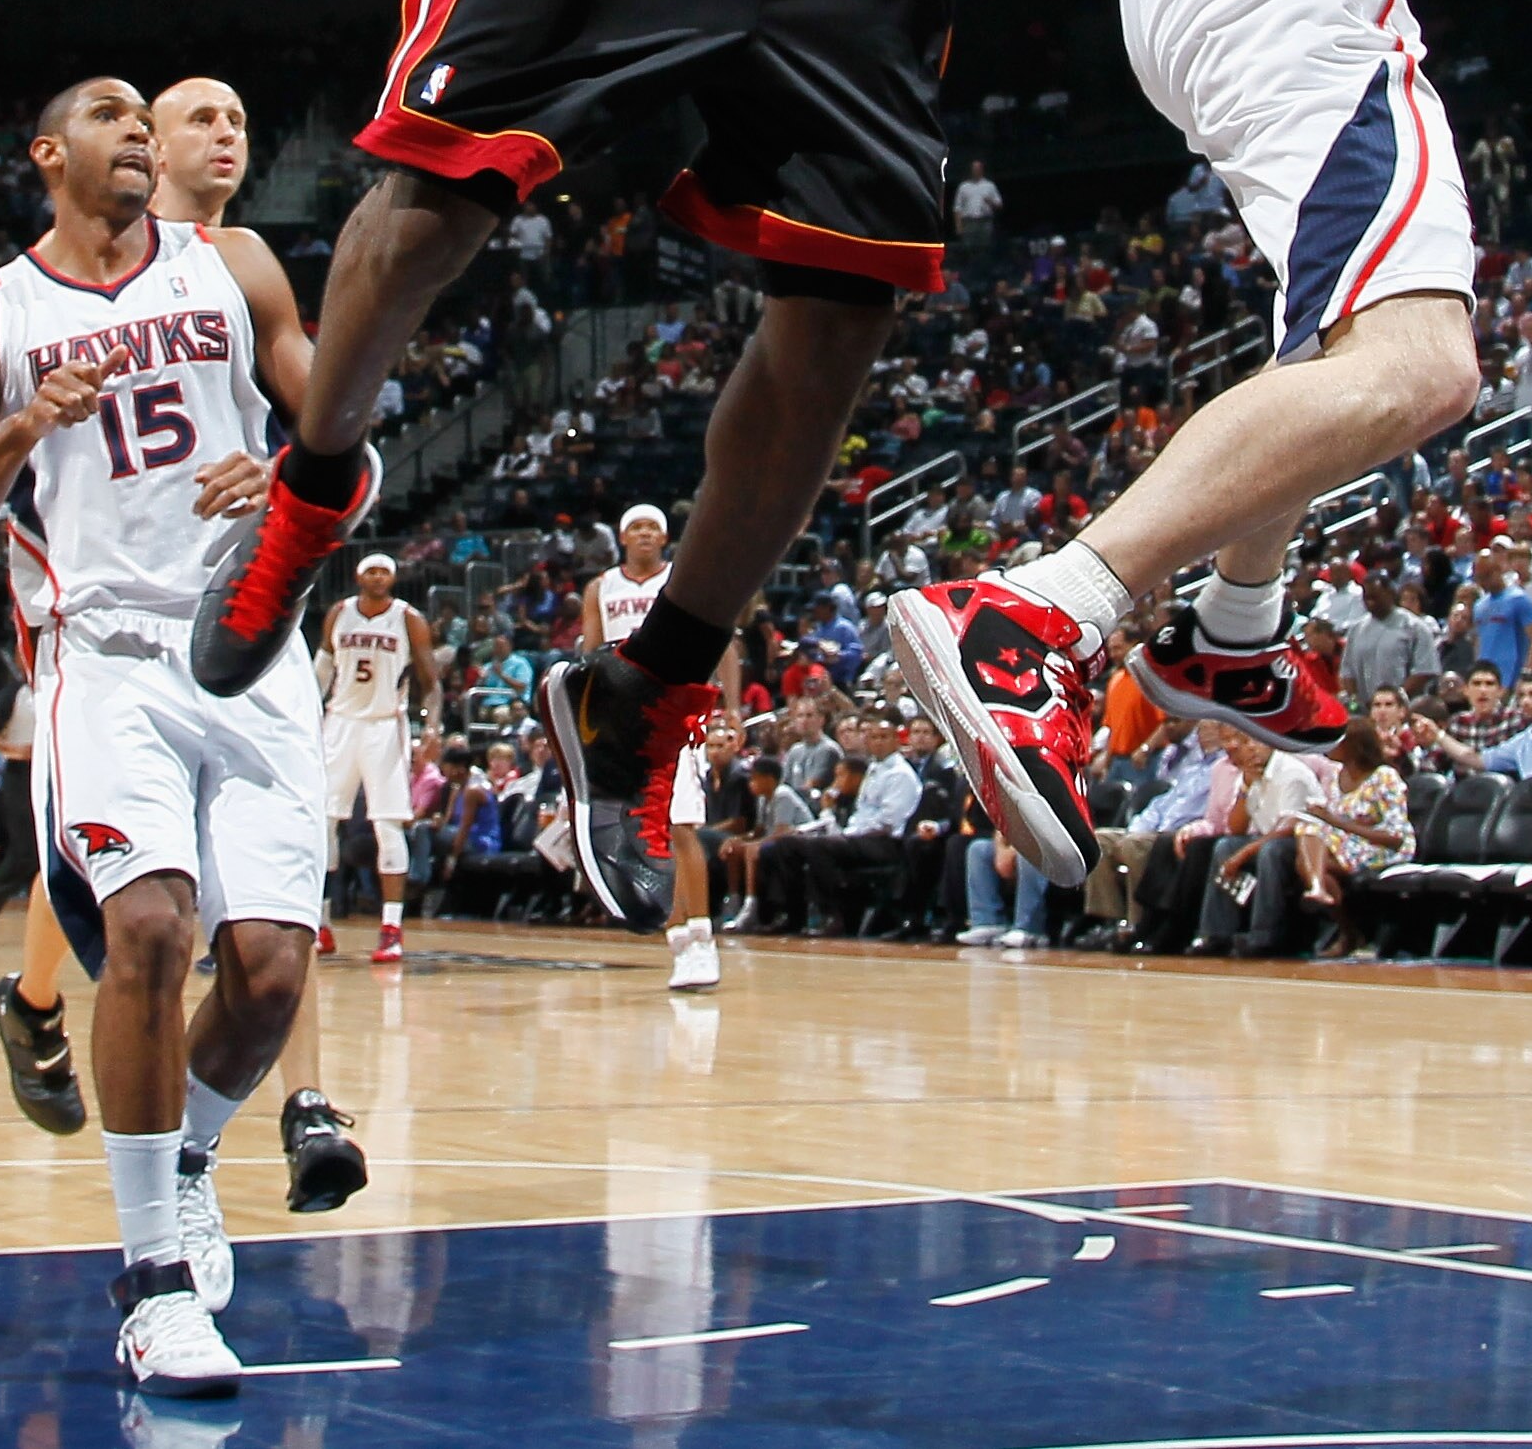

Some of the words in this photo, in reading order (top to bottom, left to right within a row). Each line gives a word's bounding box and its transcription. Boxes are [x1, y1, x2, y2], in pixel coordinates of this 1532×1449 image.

[27, 309, 231, 393] HAWKS
[98, 379, 197, 481] 15
[340, 631, 397, 653] HAWKS
[356, 659, 374, 683] 5
